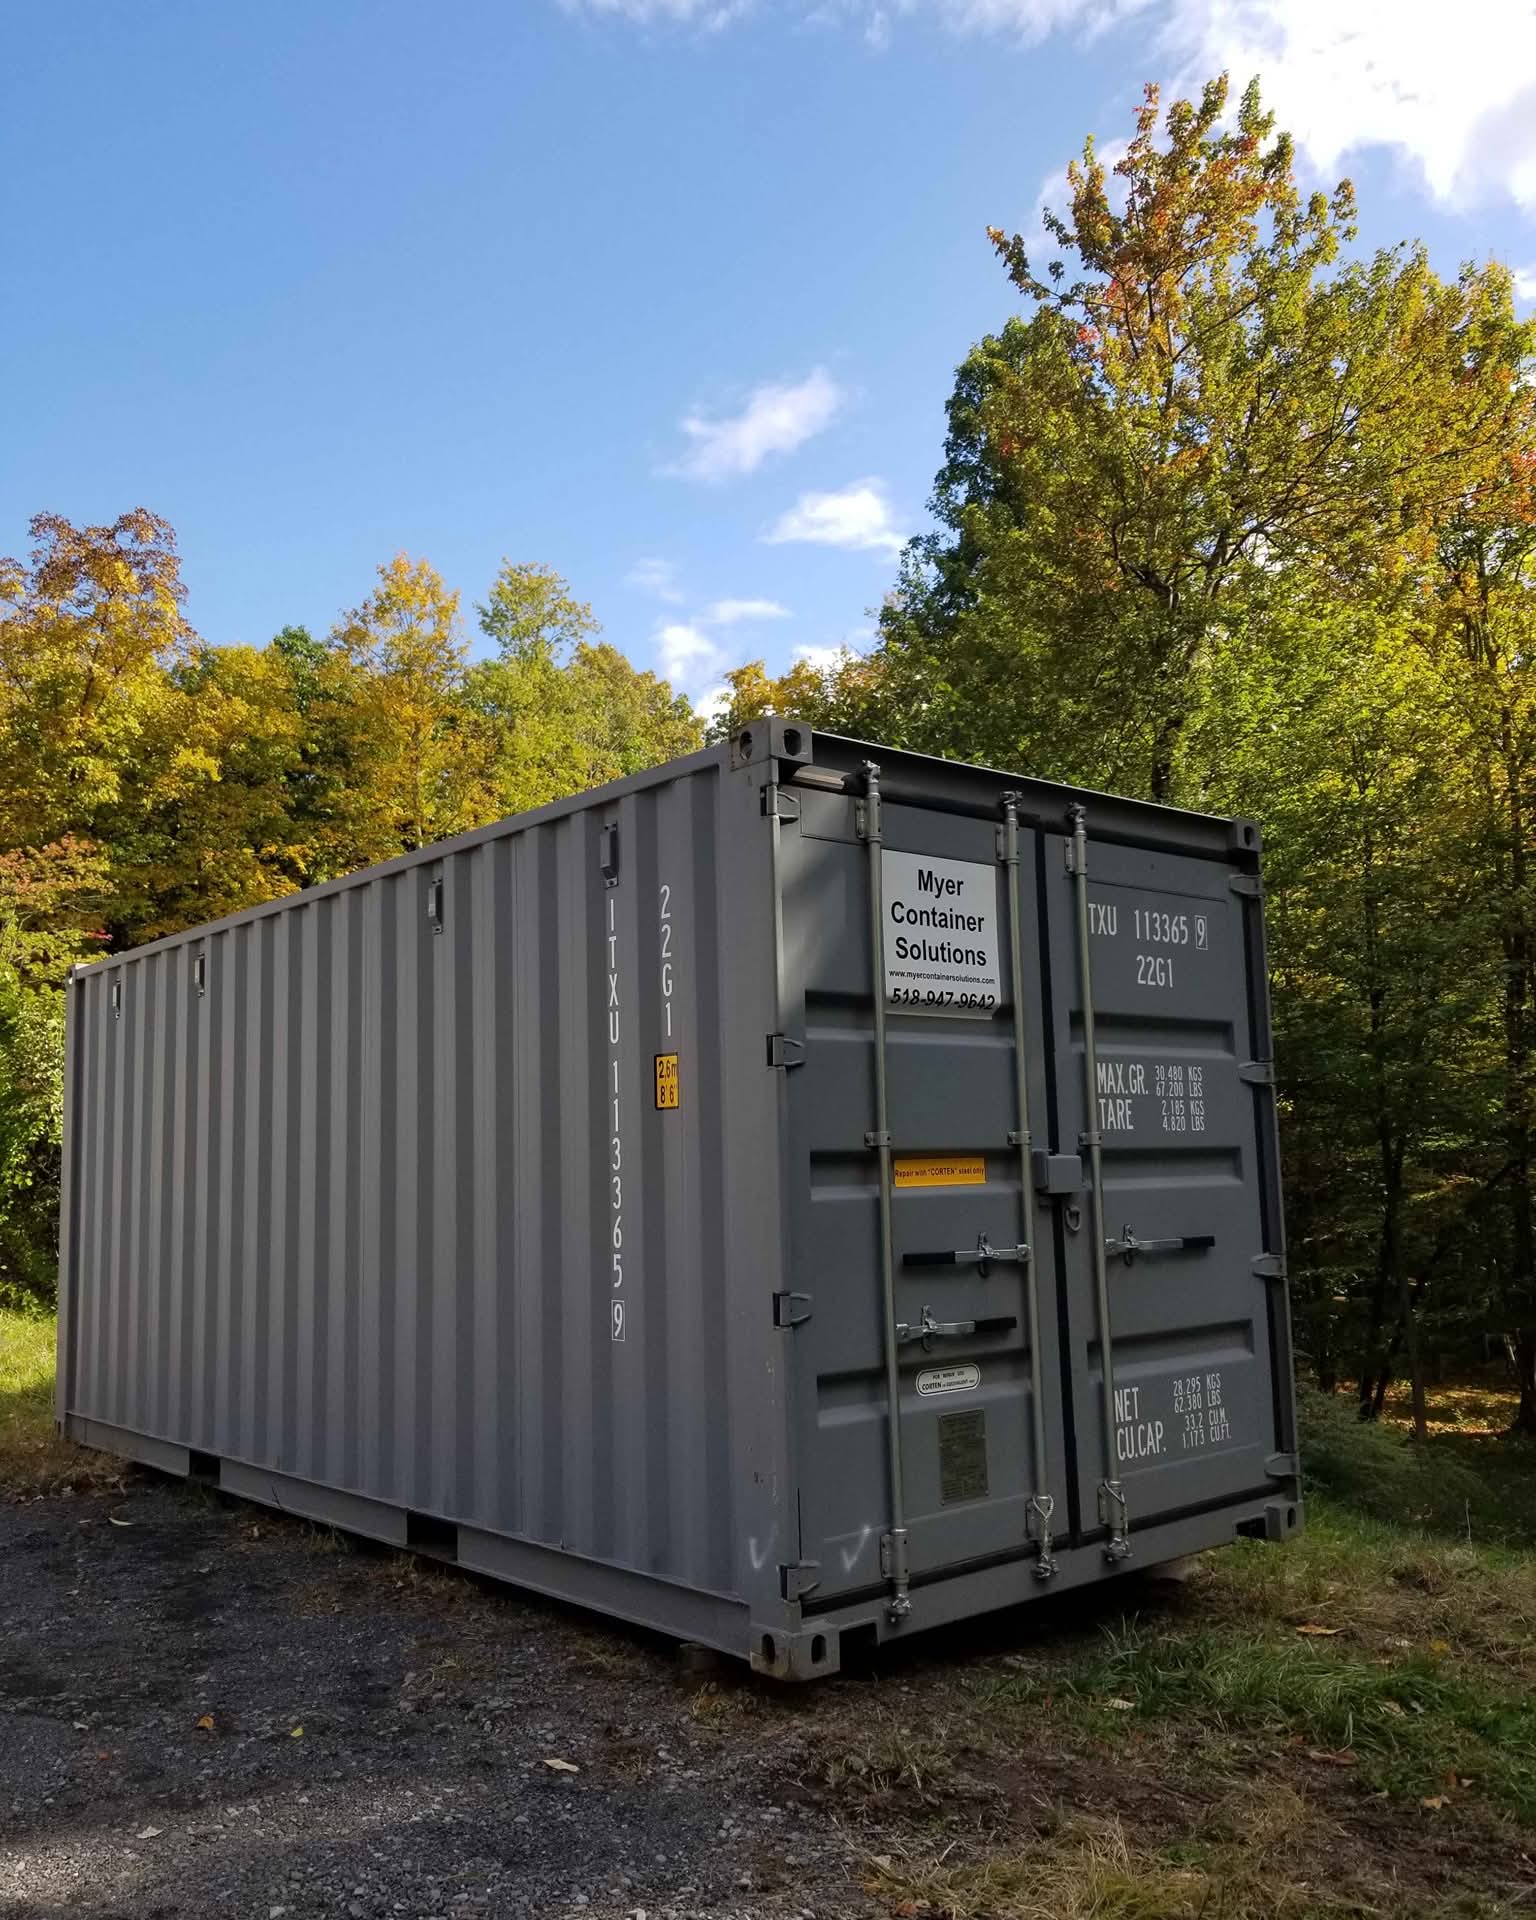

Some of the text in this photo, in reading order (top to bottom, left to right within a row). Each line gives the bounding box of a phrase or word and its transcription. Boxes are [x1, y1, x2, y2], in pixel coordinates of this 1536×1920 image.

[917, 869, 964, 898] Myer
[891, 901, 984, 932] Container
[1134, 909, 1188, 945] 113365
[1196, 917, 1206, 947] 9
[660, 884, 673, 1037] 22G1
[895, 936, 987, 966] Solutions
[889, 969, 995, 985] www.myercontainersolutions.com
[1136, 955, 1174, 988] 22G1
[890, 988, 995, 1010] 518-947-9642
[1097, 1062, 1149, 1095] MAX.GR.
[1154, 1065, 1203, 1081] 30.480 KGS
[1155, 1081, 1203, 1098] 67.200 LBS
[1098, 1098, 1134, 1130] TARE
[1161, 1100, 1205, 1116] 2.185 KGS
[1162, 1116, 1205, 1132] 4.820 LBS
[612, 1060, 623, 1288] 113365
[895, 1169, 913, 1179] Repair
[613, 1302, 624, 1339] 9
[1173, 1372, 1222, 1397] 28.295 KGS
[1114, 1386, 1139, 1423] NET
[1174, 1389, 1222, 1414] 62.380 LBS
[1185, 1412, 1203, 1431] 33.2
[1116, 1421, 1167, 1461] CU.CAP.
[1182, 1428, 1204, 1449] 1.173
